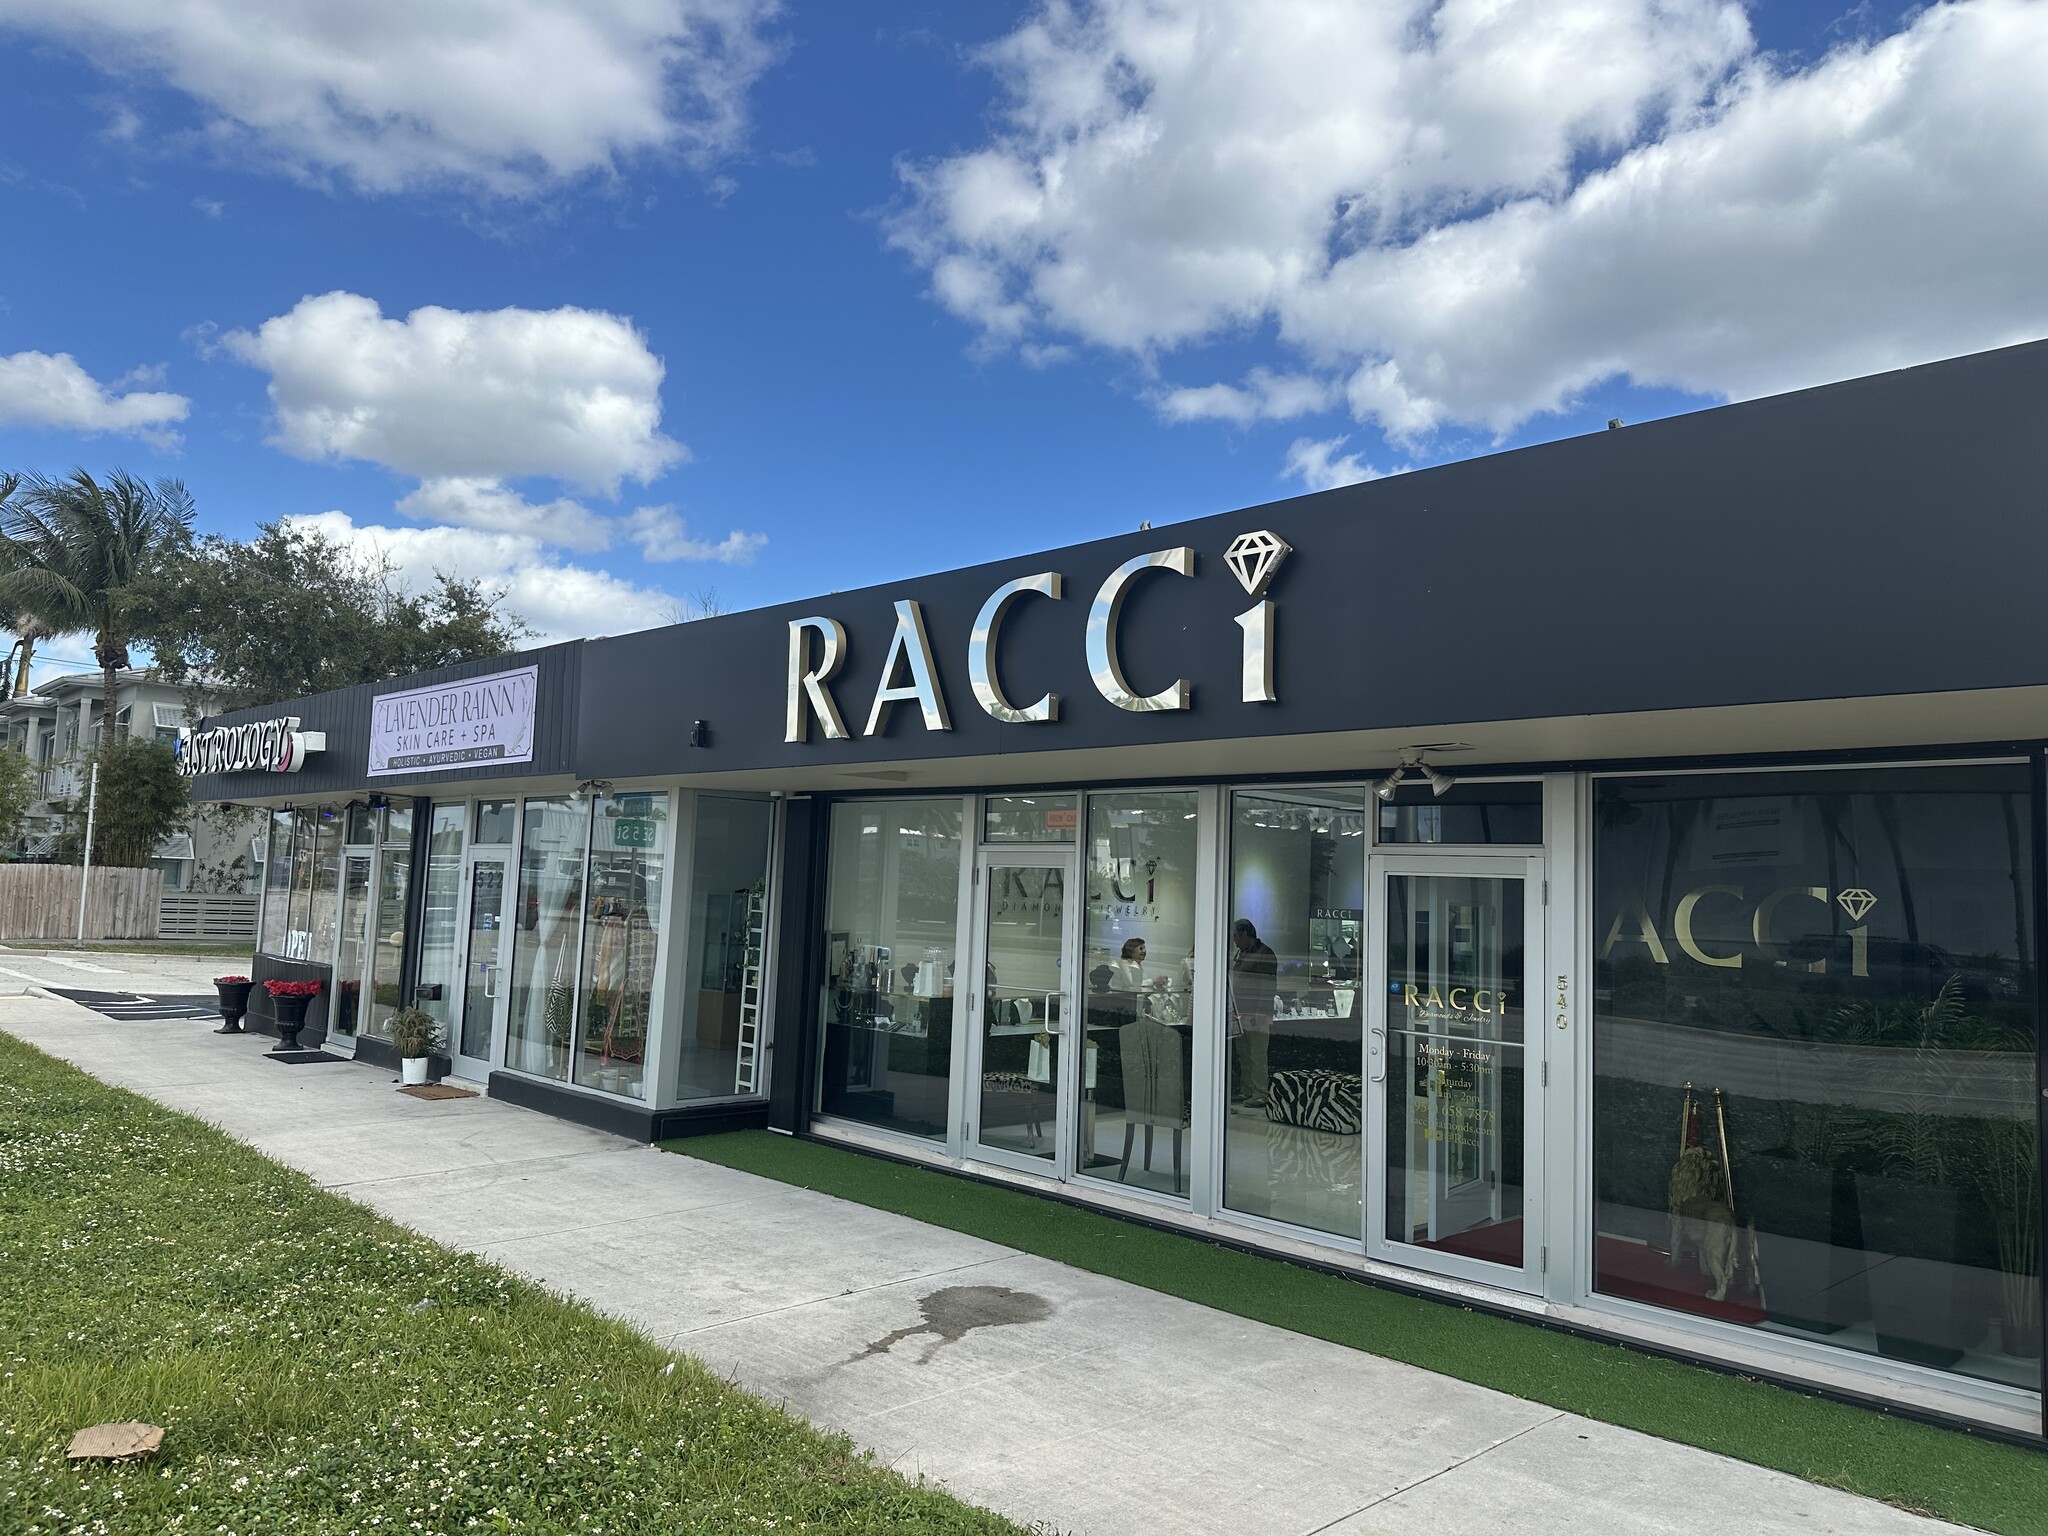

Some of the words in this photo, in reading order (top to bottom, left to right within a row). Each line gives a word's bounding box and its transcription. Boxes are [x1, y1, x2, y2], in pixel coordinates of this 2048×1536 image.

[784, 530, 1291, 743] RACCi
[385, 692, 457, 734] LAVENDER
[461, 682, 518, 722] RAINN
[180, 716, 290, 776] ASTROLOGY
[396, 733, 421, 752] SKIN
[426, 729, 455, 749] CARE
[460, 731, 467, 742] +
[473, 722, 496, 743] SPA
[394, 756, 421, 768] HOLISTIC
[428, 751, 466, 764] AYURVEDIC
[473, 747, 498, 759] VEGAN
[476, 871, 503, 889] 522
[1317, 908, 1352, 919] RACCi
[1404, 984, 1507, 1015] RACCi
[1556, 974, 1569, 1030] 540
[1454, 1011, 1463, 1020] &
[1419, 1043, 1454, 1059] Monday
[1463, 1048, 1491, 1063] Friday
[1416, 1057, 1452, 1069] 10:30am
[1461, 1062, 1494, 1075] 5:30pm
[1436, 1074, 1473, 1090] Saturday
[1460, 1091, 1480, 1103] 2pm
[1441, 1105, 1463, 1118] 658
[1468, 1107, 1496, 1122] 7878
